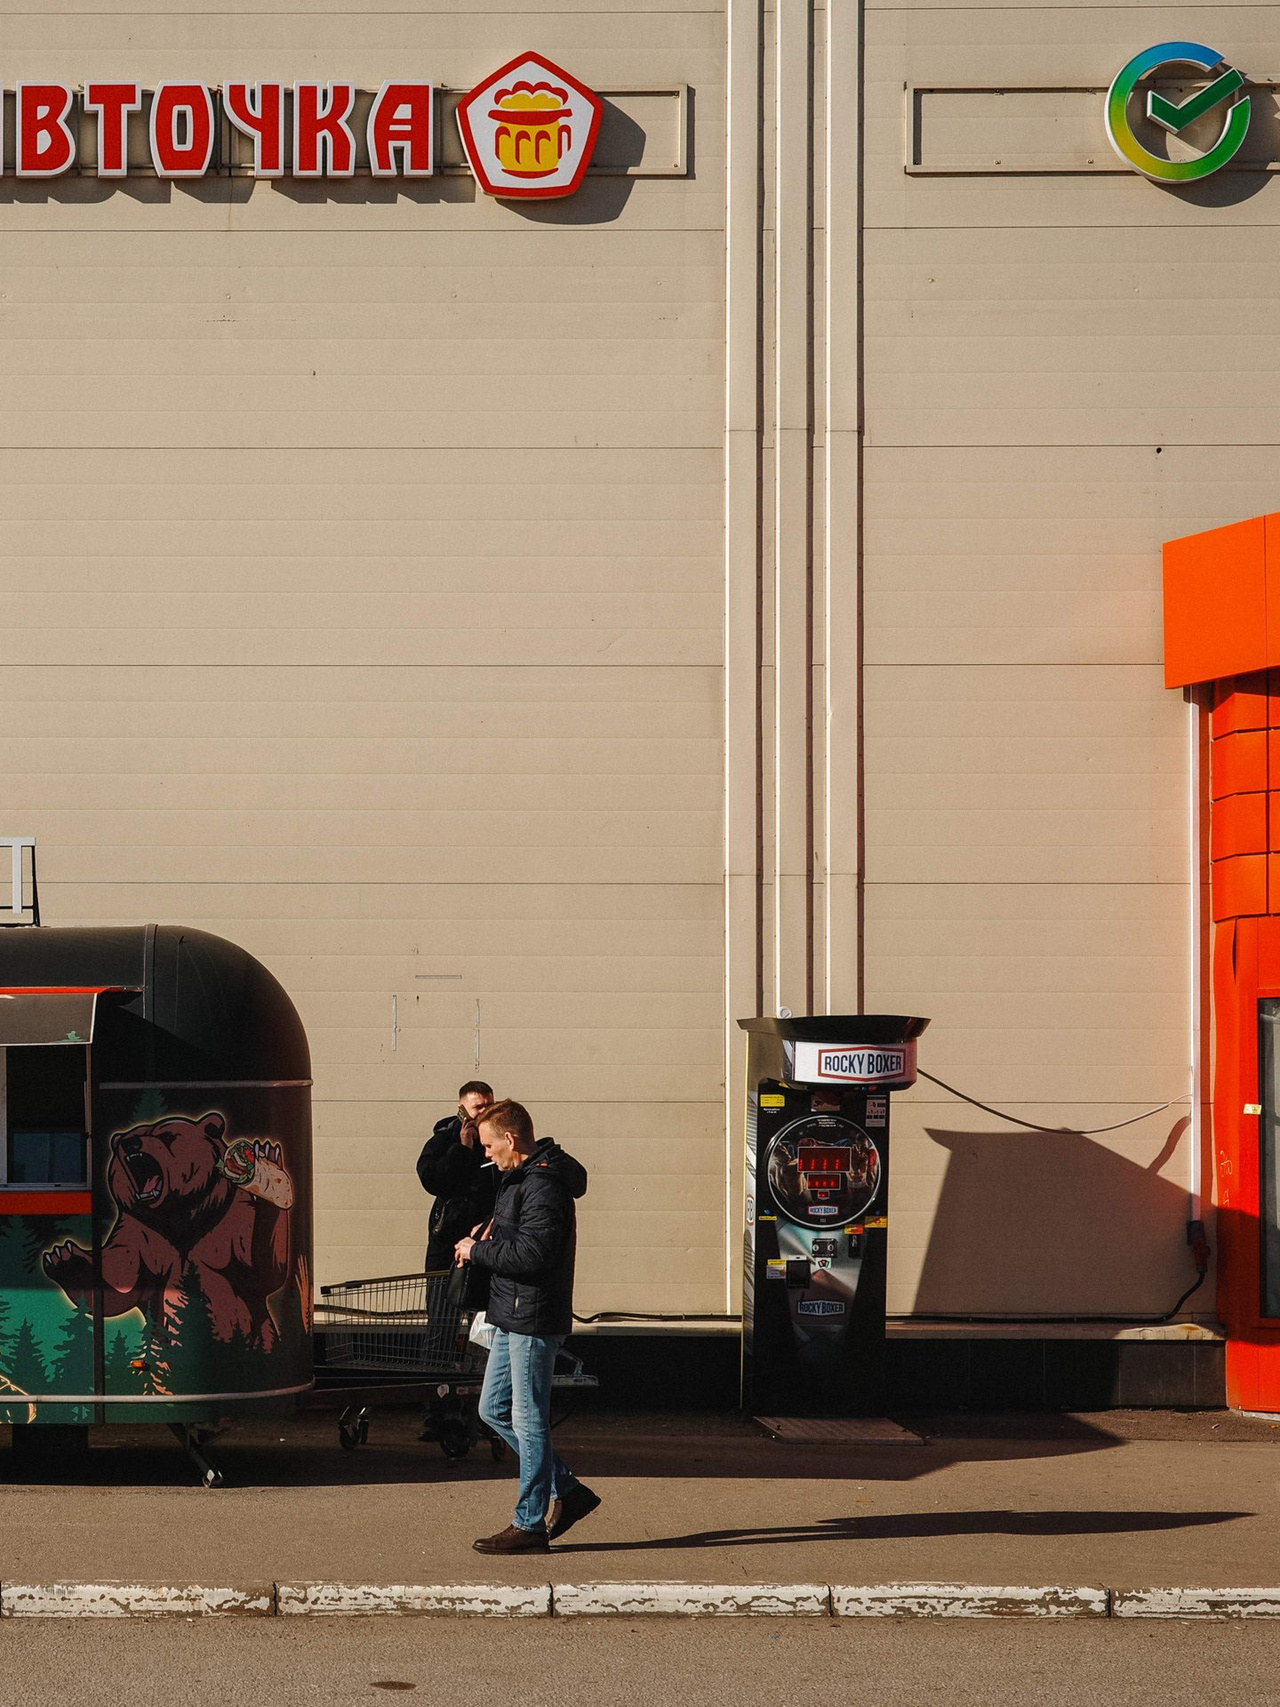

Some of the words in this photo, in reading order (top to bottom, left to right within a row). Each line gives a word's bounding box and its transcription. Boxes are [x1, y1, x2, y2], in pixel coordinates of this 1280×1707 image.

[824, 1053, 865, 1075] ROCKY
[867, 1053, 902, 1075] BOXER
[821, 1302, 843, 1314] BOXER
